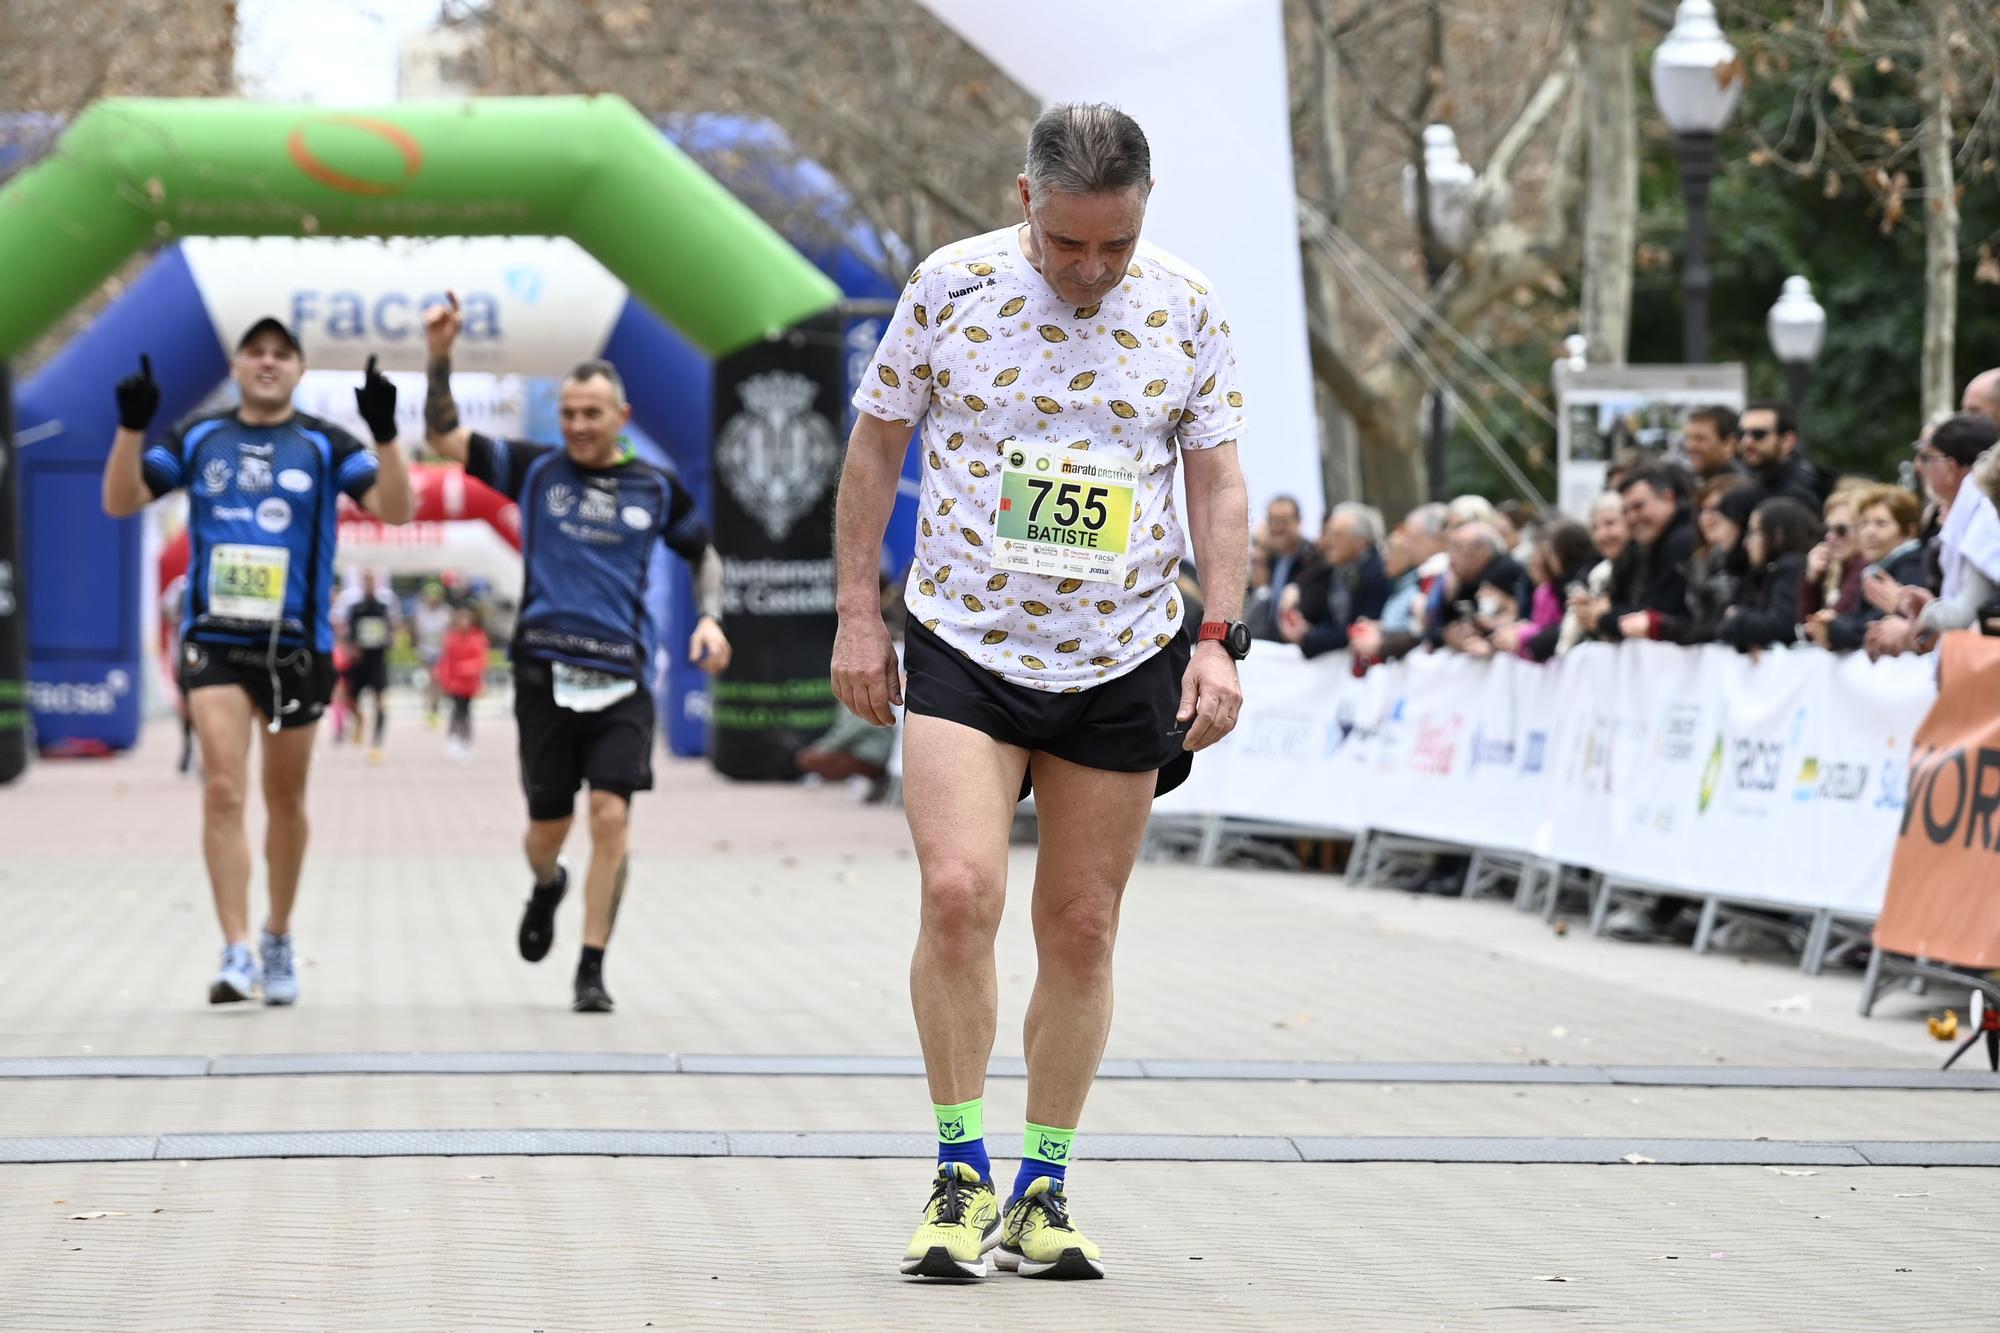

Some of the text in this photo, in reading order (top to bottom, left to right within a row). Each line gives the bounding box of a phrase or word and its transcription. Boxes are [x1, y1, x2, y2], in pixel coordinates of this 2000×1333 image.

[948, 282, 983, 299] luanvi
[1061, 463, 1096, 477] marató
[1028, 479, 1108, 530] 755
[1027, 525, 1098, 548] BATISTE
[226, 565, 271, 588] 430
